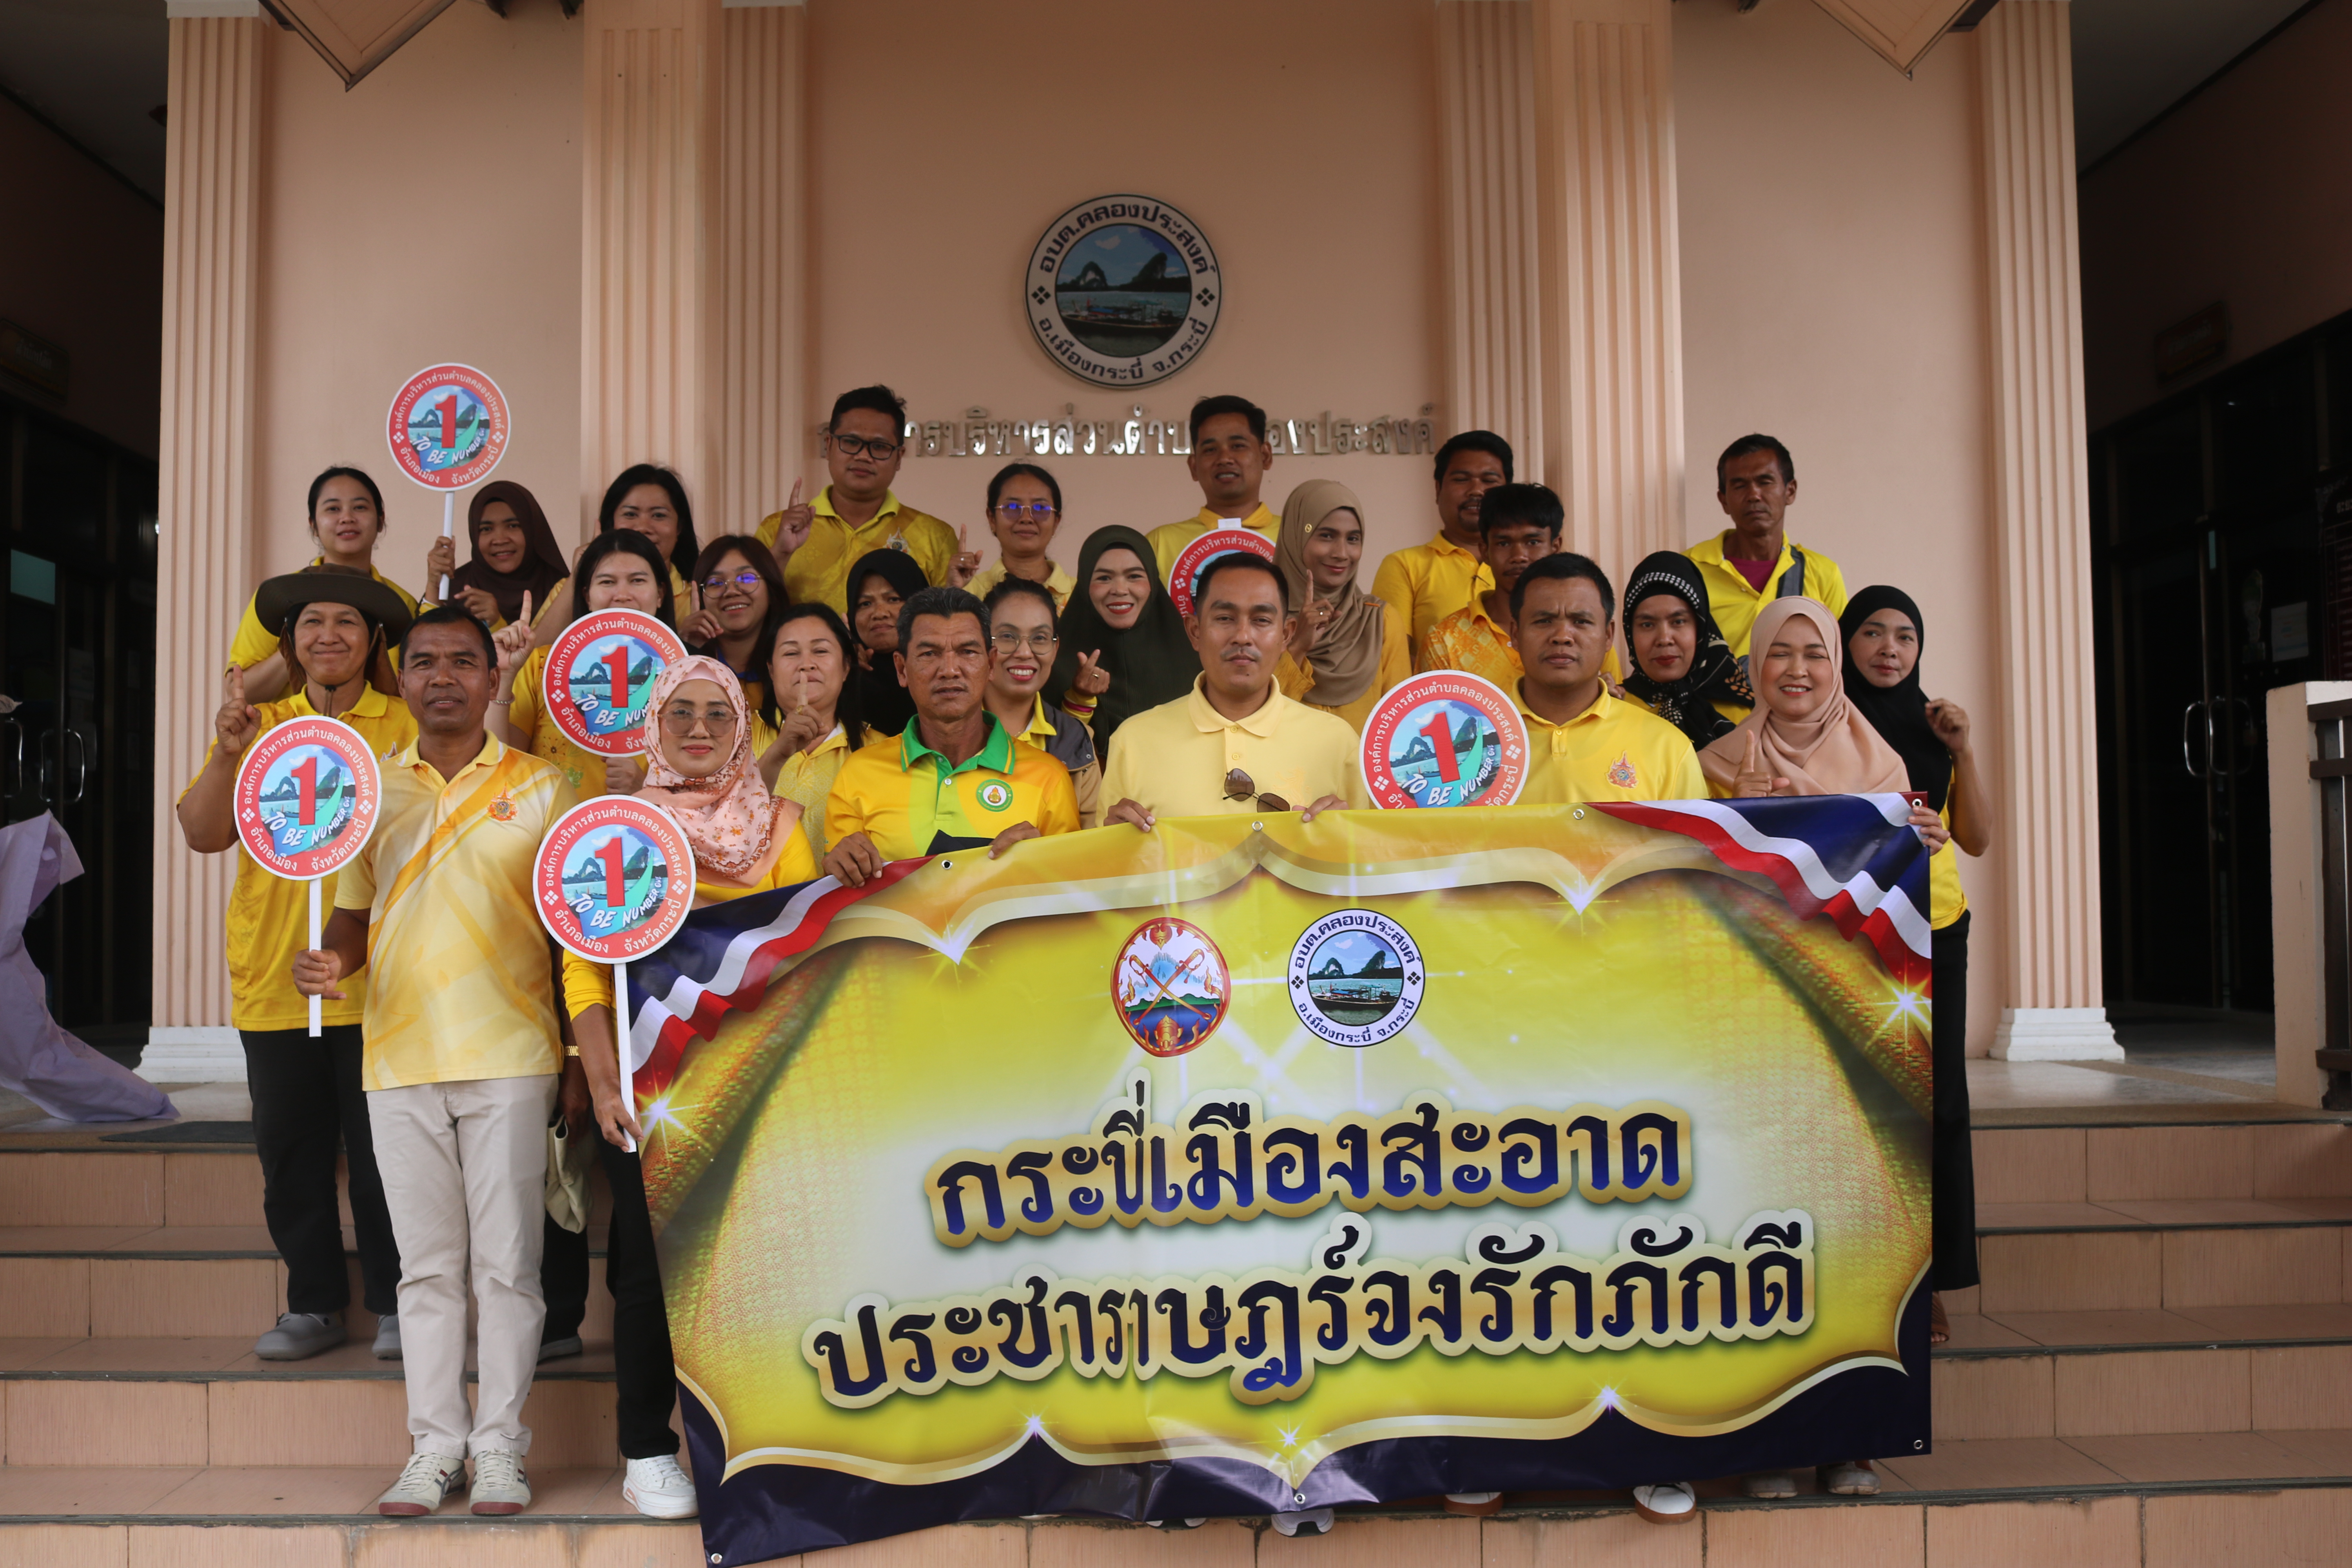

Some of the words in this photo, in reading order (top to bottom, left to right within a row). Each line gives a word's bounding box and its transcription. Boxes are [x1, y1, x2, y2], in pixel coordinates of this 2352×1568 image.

[1040, 203, 1216, 274] อบต.คลองประสงค์
[1039, 317, 1144, 380] อ.เมืองกระบี่
[1152, 316, 1208, 372] จ.กระบี่
[435, 394, 457, 448] 1
[400, 446, 440, 484] อำเภอเมือง
[451, 444, 498, 485] จังหวัดกระบี่
[412, 436, 432, 451] TO
[427, 450, 447, 464] BE
[452, 437, 483, 464] NUMBER
[601, 646, 629, 708] 1
[561, 707, 611, 749] อำเภอเมือง
[575, 694, 600, 711] TO
[594, 709, 619, 727] BE
[625, 702, 650, 727] NUM
[1368, 681, 1519, 773] องค์การบริหารส่วนตำบลคลองประสงค์
[243, 725, 374, 805] องค์การบริหารส่วนตำบลคลองประสงค์
[1419, 711, 1461, 784] 1
[290, 757, 317, 826] 1
[1401, 773, 1428, 794] TO
[1427, 786, 1454, 806] BE
[1459, 758, 1494, 801] NUMBER
[250, 826, 297, 872] อำเภอเมือง
[311, 817, 367, 872] จังหวัดกระบี่
[264, 811, 288, 831] TO
[282, 828, 307, 847] BE
[311, 808, 347, 846] NUMBER
[543, 805, 687, 887] องค์การบริหารส่วนตำบลคลองประสงค์
[594, 837, 626, 907] 1
[555, 909, 609, 953] อำเภอเมือง
[624, 897, 681, 953] จังหวัดกระบี่
[569, 893, 595, 913] TO
[590, 909, 617, 929] BE
[622, 888, 661, 927] NUMBER
[1295, 915, 1421, 969] อบต.คลองประสงค์
[1299, 1003, 1371, 1042] อ.เมืองกระบี่
[1377, 997, 1415, 1037] จ.กระบี่
[937, 1080, 1680, 1235] กระบี่เมืองสะอาด
[813, 1221, 1804, 1397] ประชาราษฎร์จงรักภักดี
